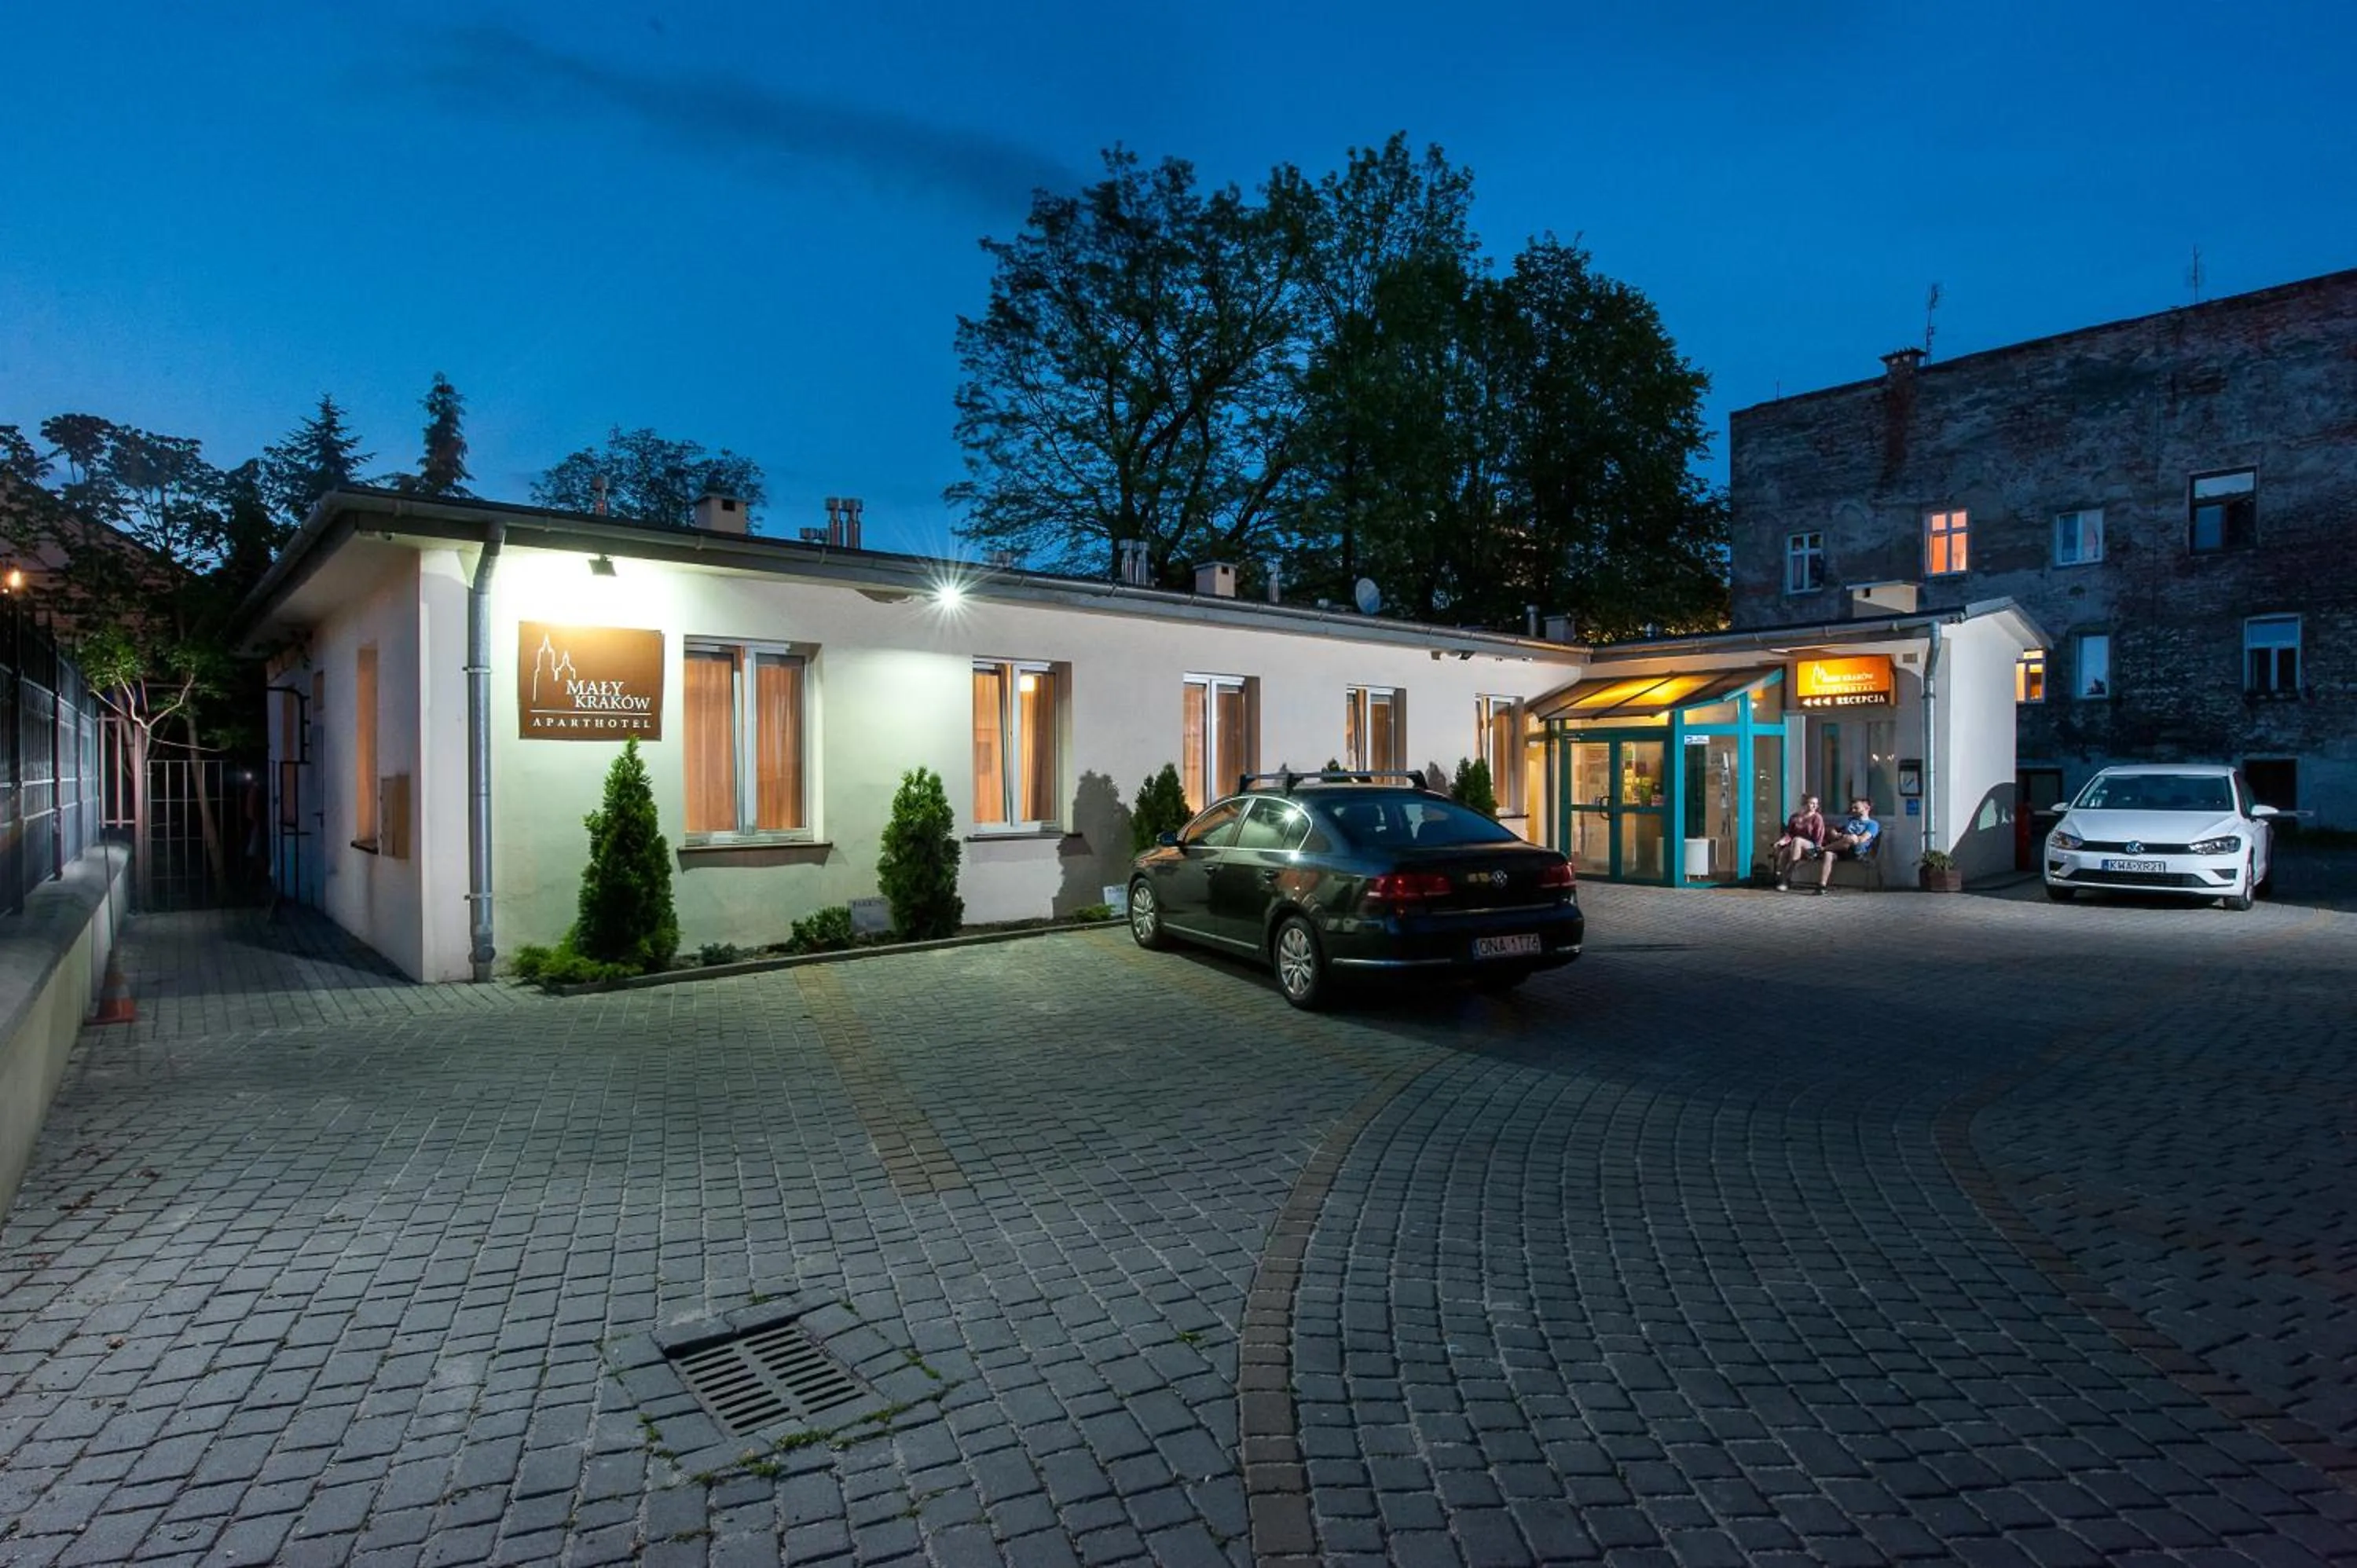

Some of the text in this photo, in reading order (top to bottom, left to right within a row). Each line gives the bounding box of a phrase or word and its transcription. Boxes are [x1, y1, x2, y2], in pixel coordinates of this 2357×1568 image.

[566, 680, 625, 696] MAŁY
[575, 694, 651, 709] KRAKÓW
[1835, 694, 1886, 705] RECEPCJA
[533, 717, 651, 728] APARTHOTEL
